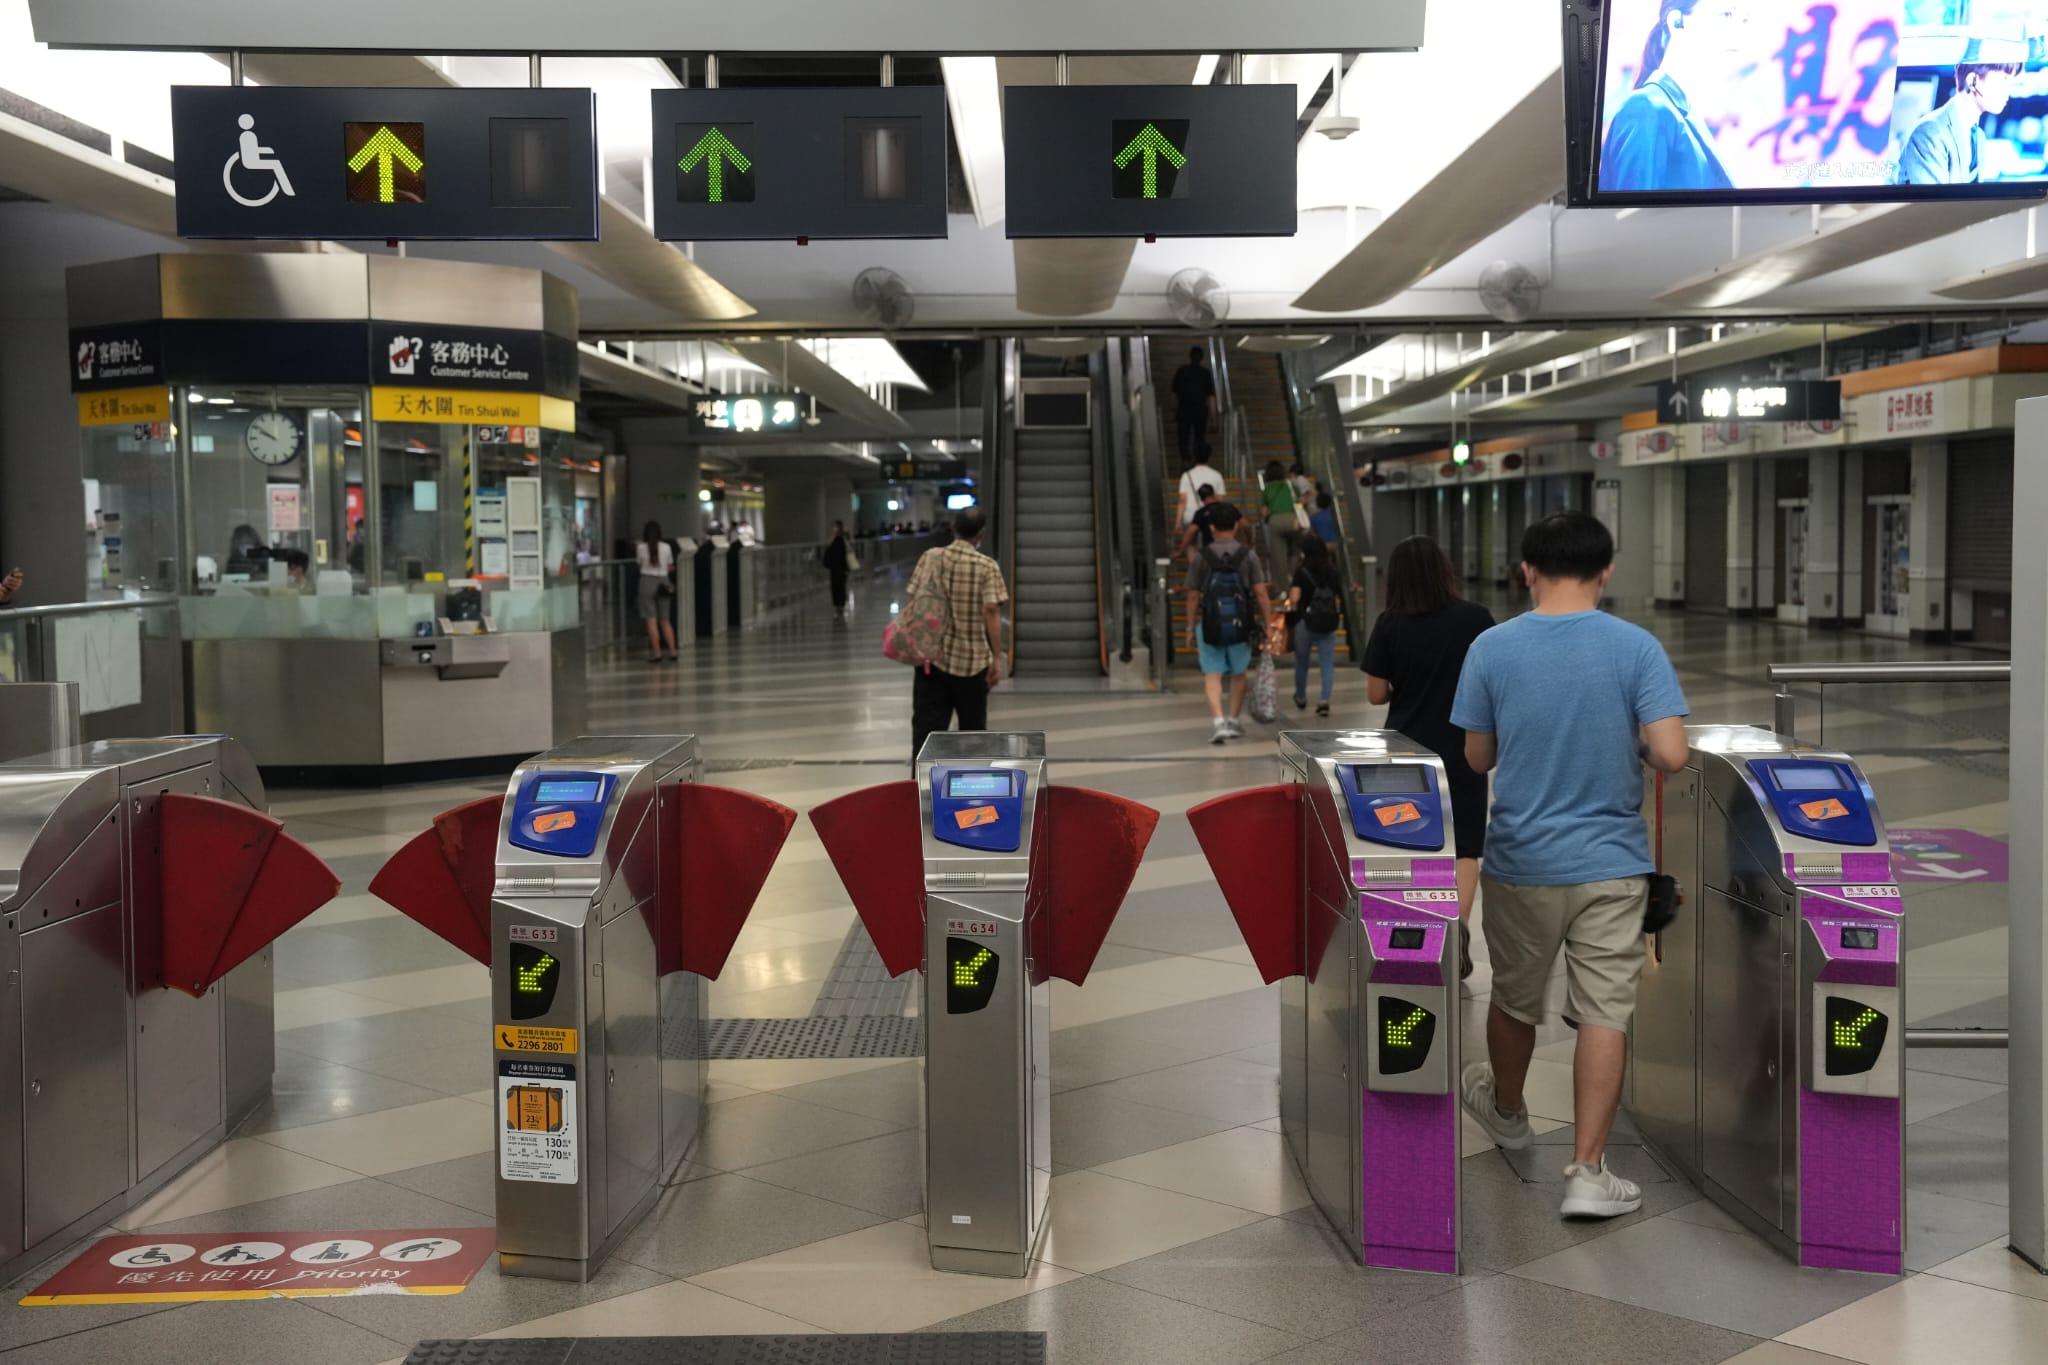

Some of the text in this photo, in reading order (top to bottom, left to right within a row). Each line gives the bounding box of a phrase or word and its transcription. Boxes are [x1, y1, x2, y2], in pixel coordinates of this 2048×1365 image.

[430, 340, 509, 366] 客務中心
[430, 365, 529, 381] Customer Service Centre
[394, 393, 453, 417] 天水圍
[458, 404, 521, 418] Tin Shui Wai
[1895, 391, 1933, 419] 中原地產
[1430, 892, 1456, 900] G35
[1871, 887, 1898, 896] G36
[532, 929, 555, 940] G33
[970, 923, 994, 934] G34
[518, 1040, 563, 1051] 2296 2801
[546, 1137, 562, 1148] 130
[546, 1150, 562, 1159] 170
[118, 1268, 279, 1285] 優先使用
[295, 1267, 411, 1282] Priority
